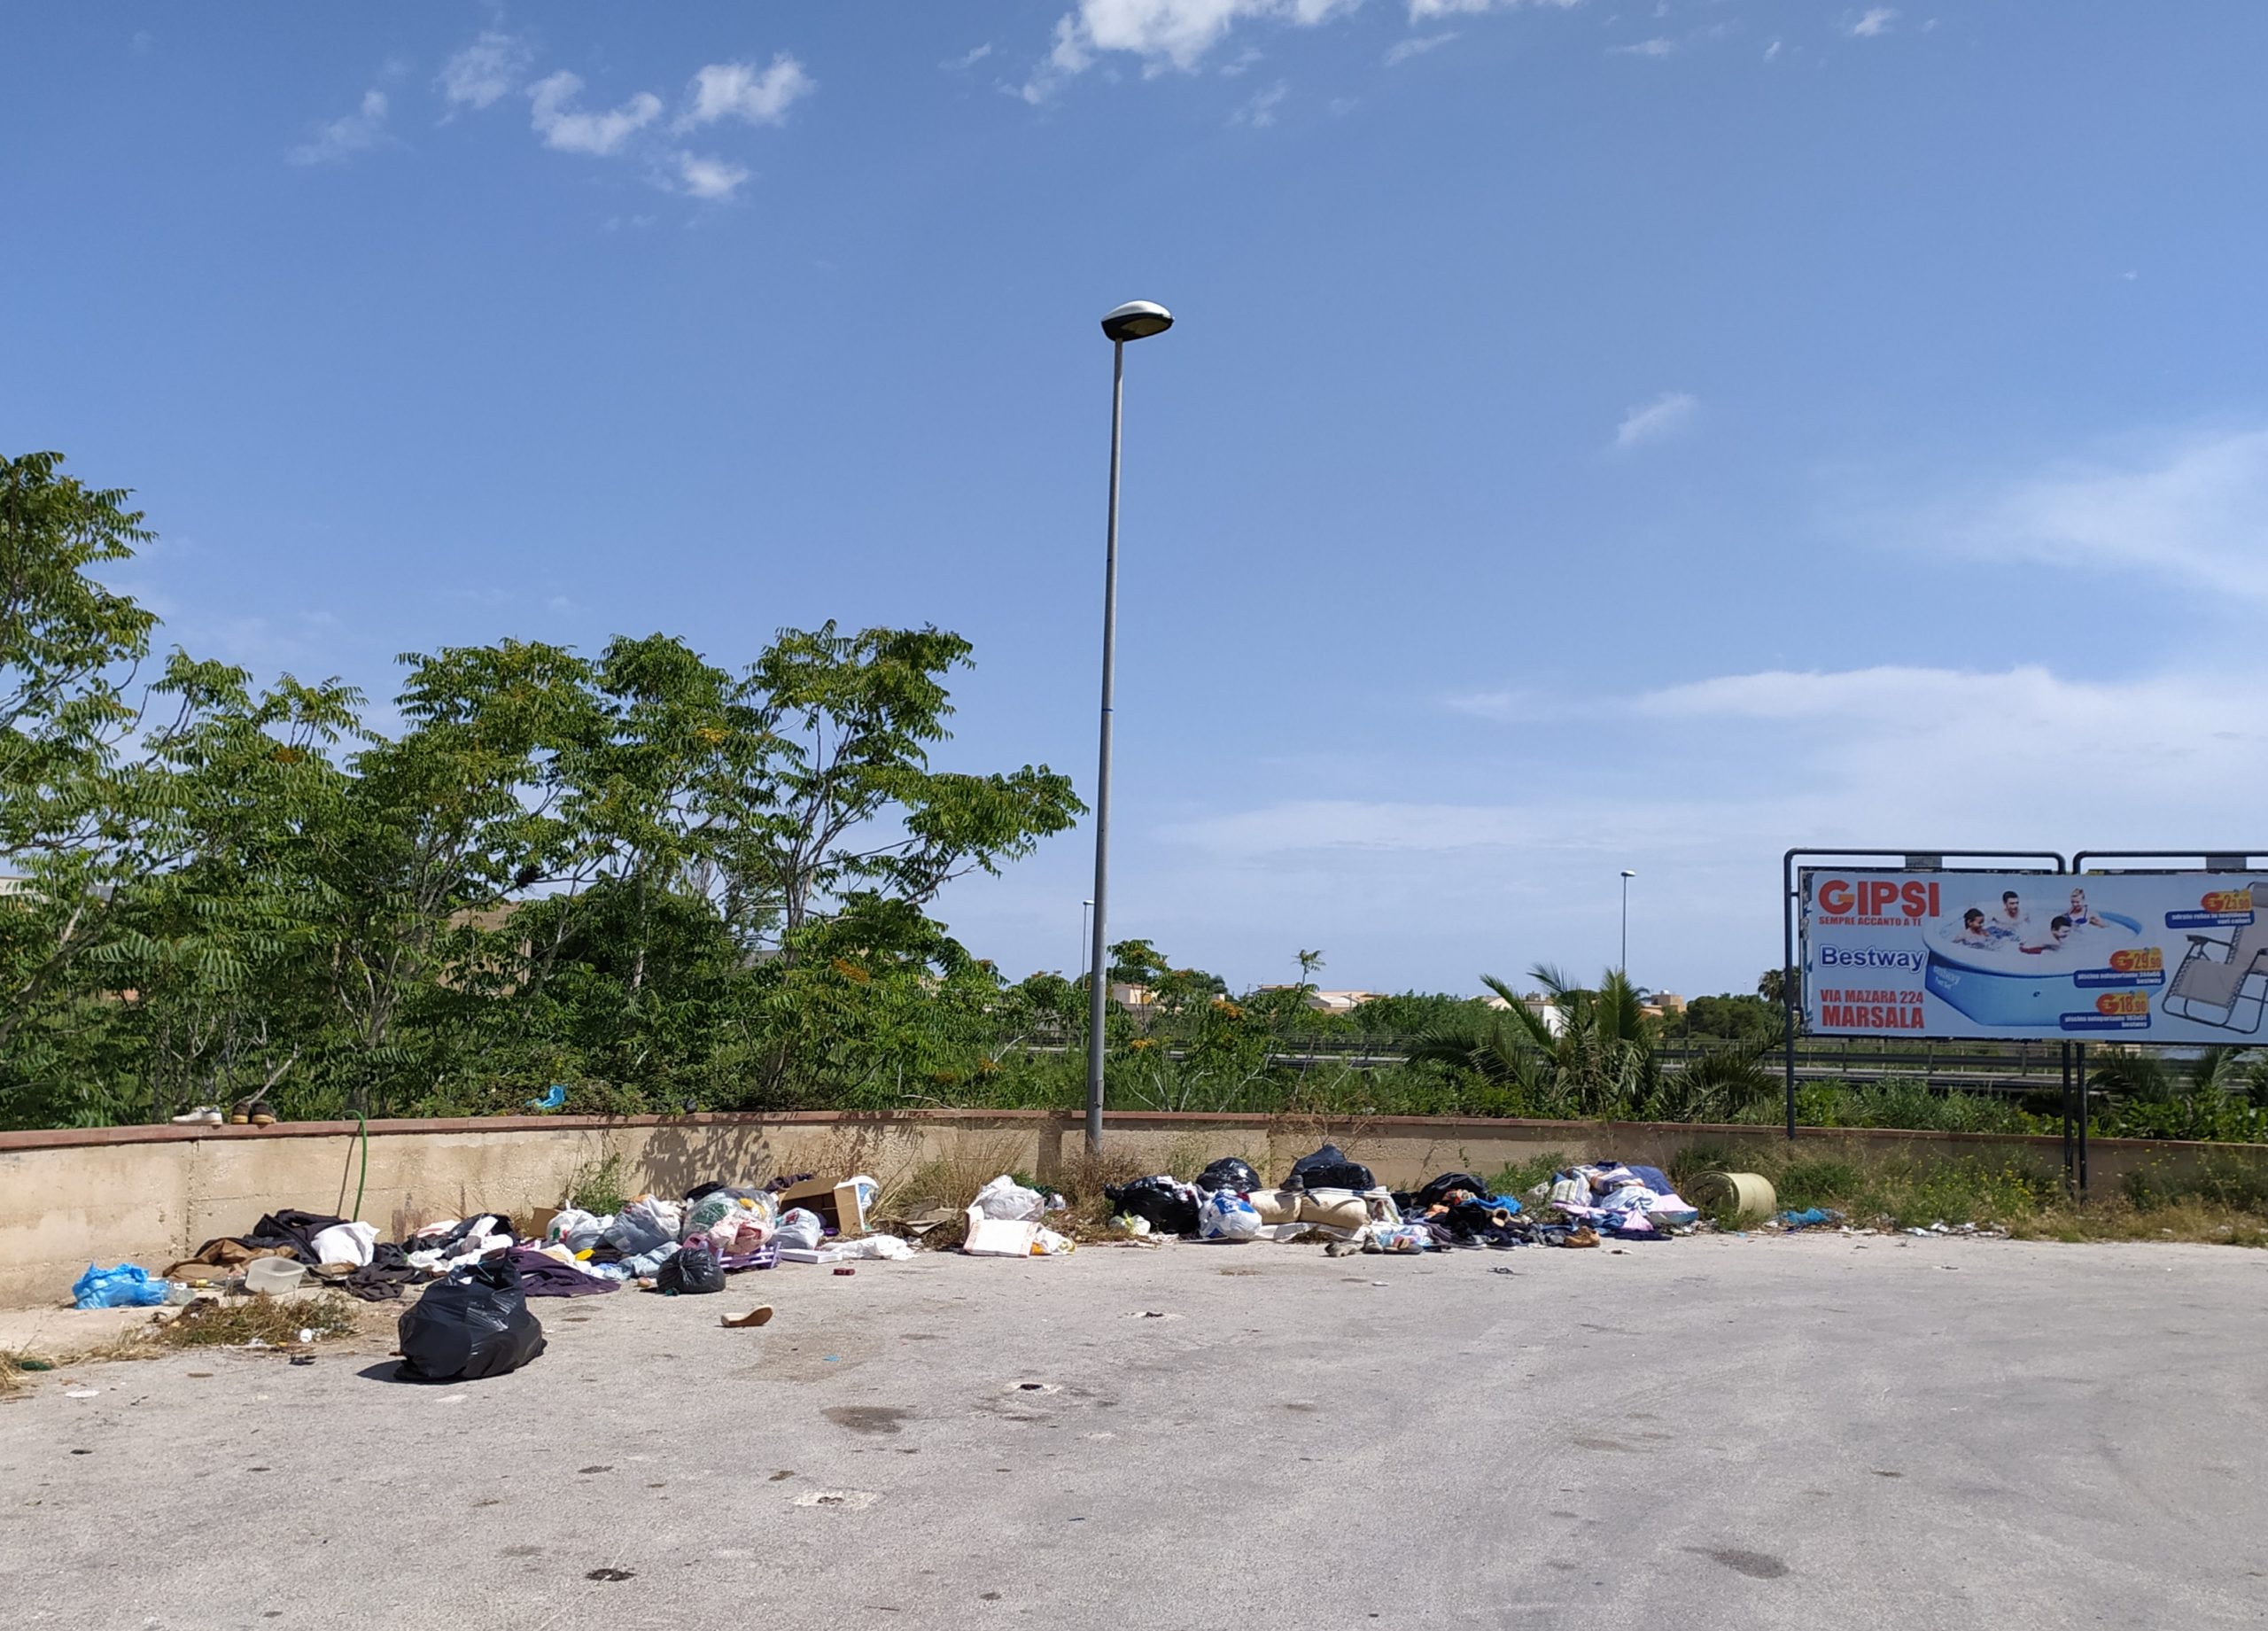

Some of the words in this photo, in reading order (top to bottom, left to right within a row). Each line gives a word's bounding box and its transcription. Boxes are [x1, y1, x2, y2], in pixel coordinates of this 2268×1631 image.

[1818, 880, 1940, 918] GIPSI
[1819, 917, 1856, 926] SEMPRE
[1857, 917, 1901, 927] ACCANTO
[1903, 918, 1910, 927] A
[1821, 946, 1925, 972] Bestway
[1820, 989, 1842, 1003] VIA
[1845, 990, 1897, 1004] MAZARA
[1899, 990, 1924, 1004] 224
[1821, 1005, 1925, 1029] MARSALA
